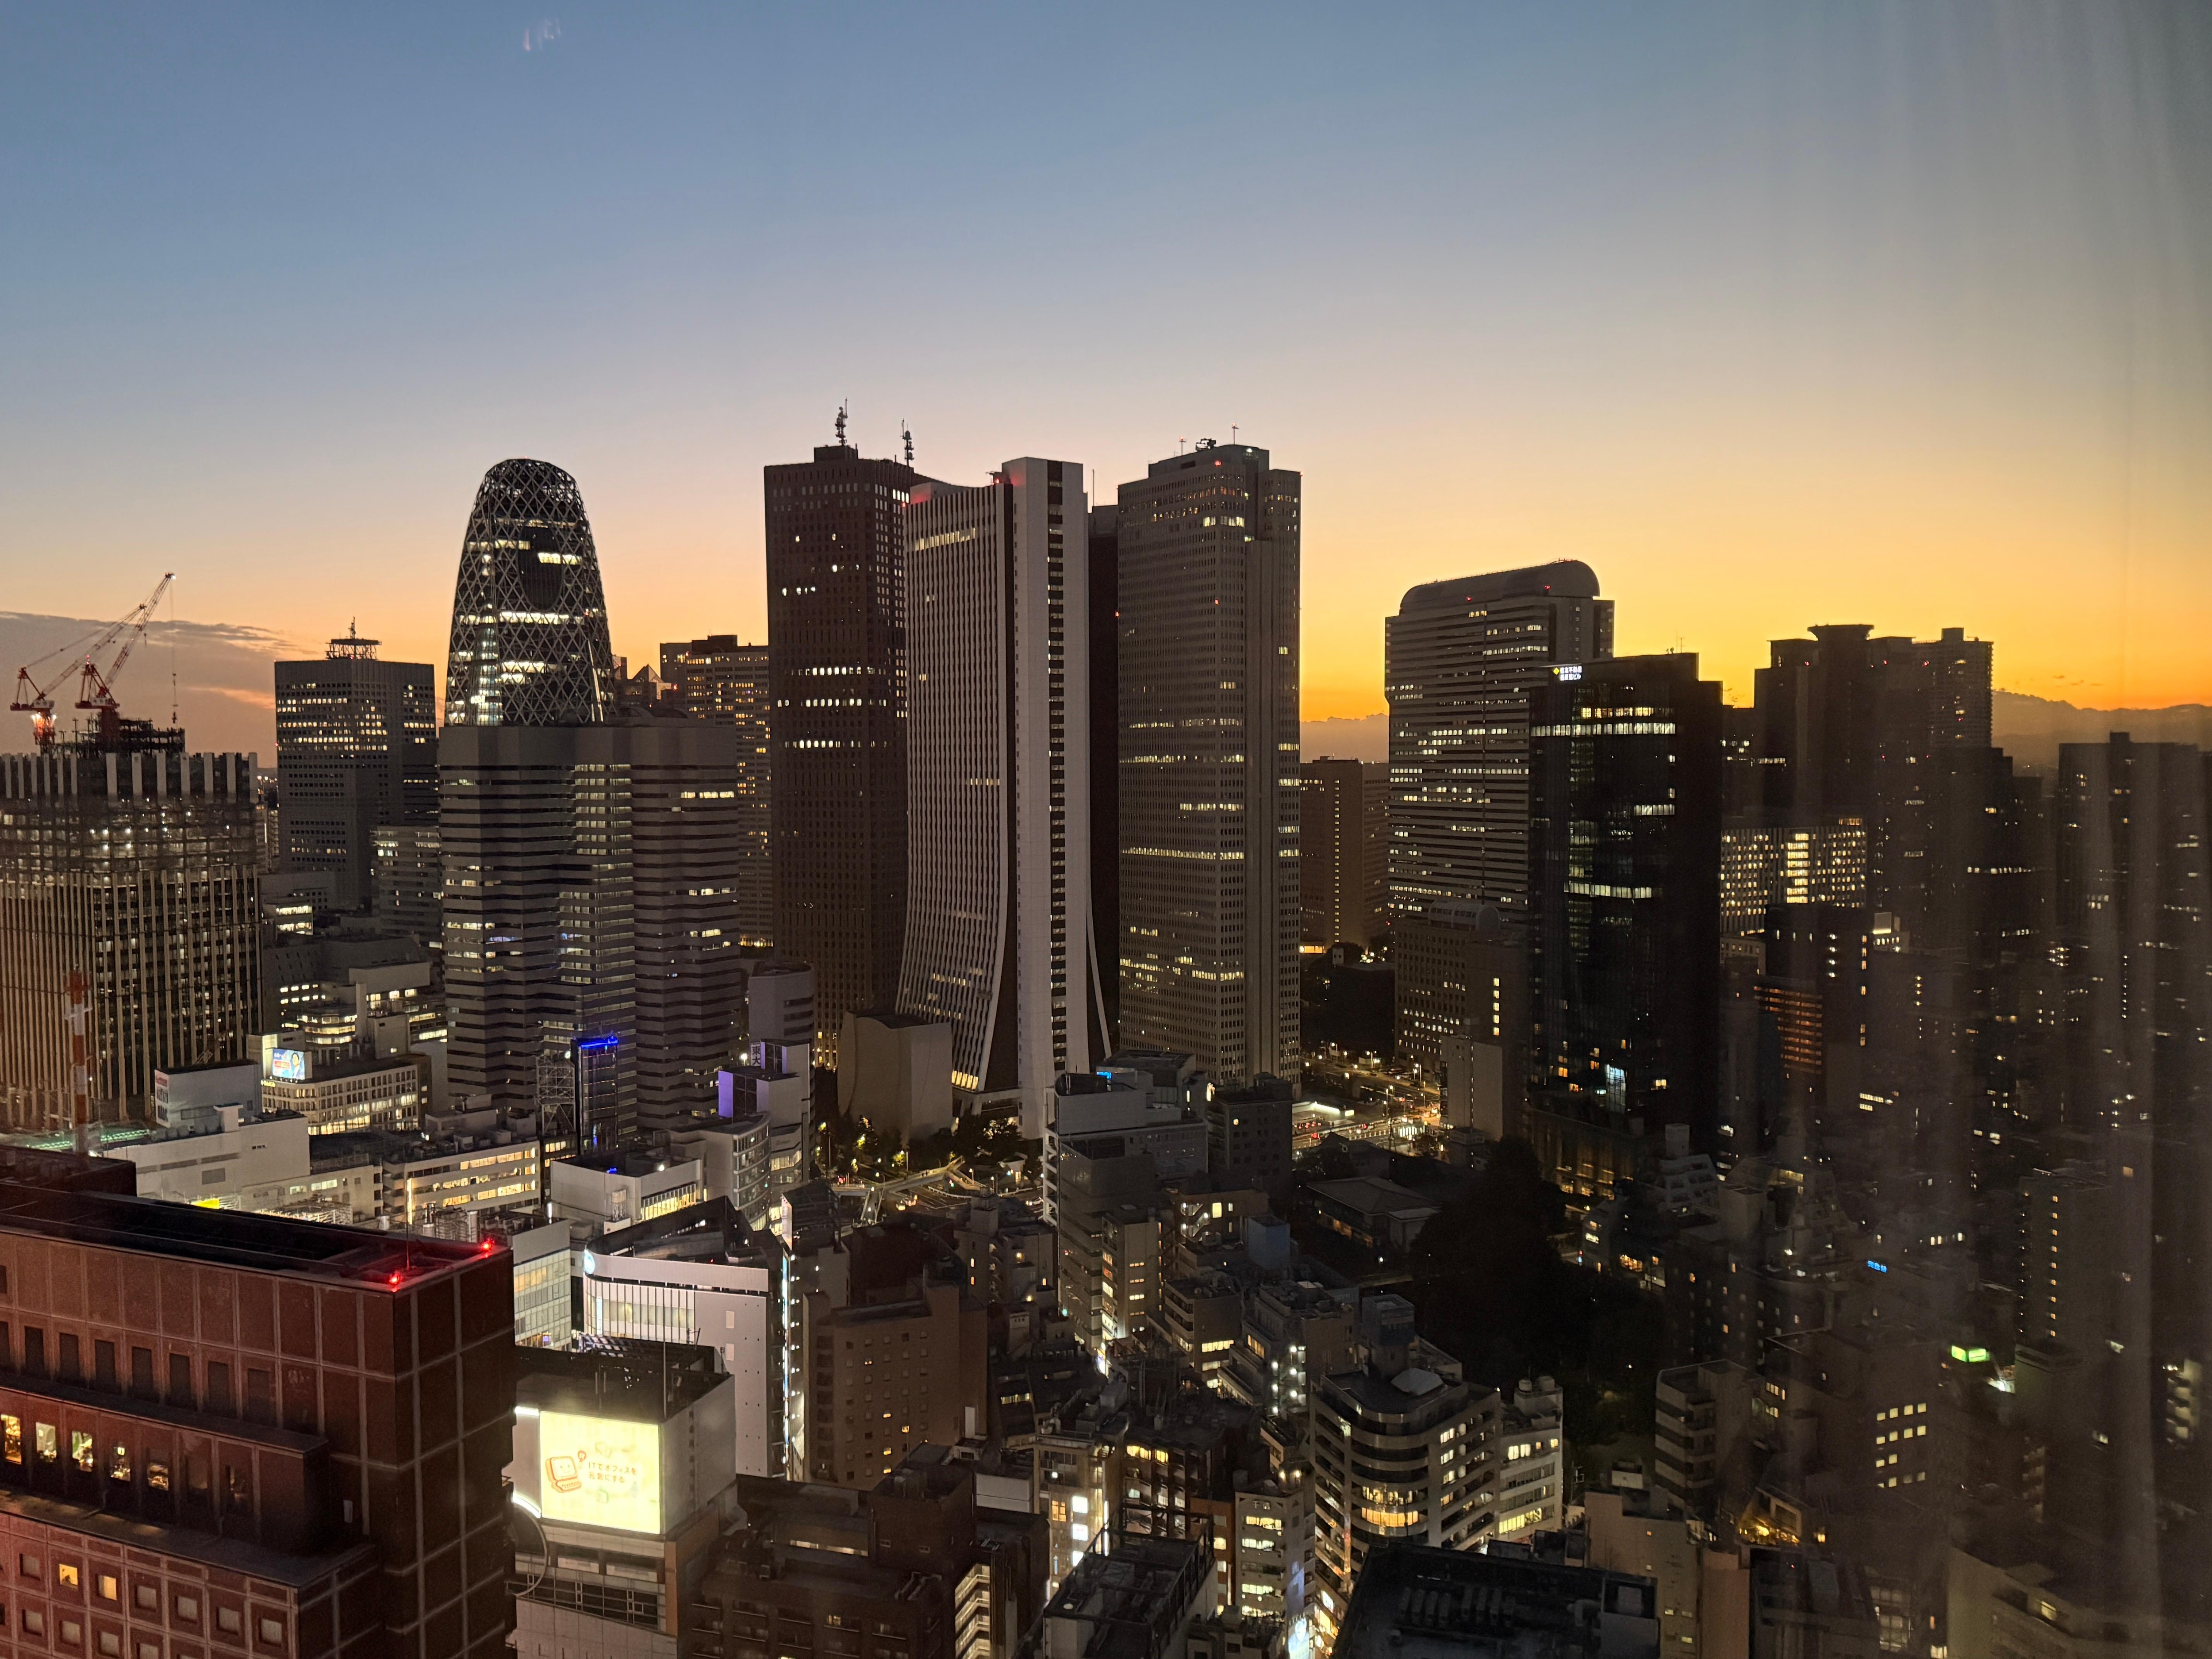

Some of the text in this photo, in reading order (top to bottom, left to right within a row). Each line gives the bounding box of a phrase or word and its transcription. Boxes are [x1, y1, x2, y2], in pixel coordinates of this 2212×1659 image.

[588, 1462, 637, 1475] ITでオフィスを
[589, 1471, 625, 1483] 元気にする
